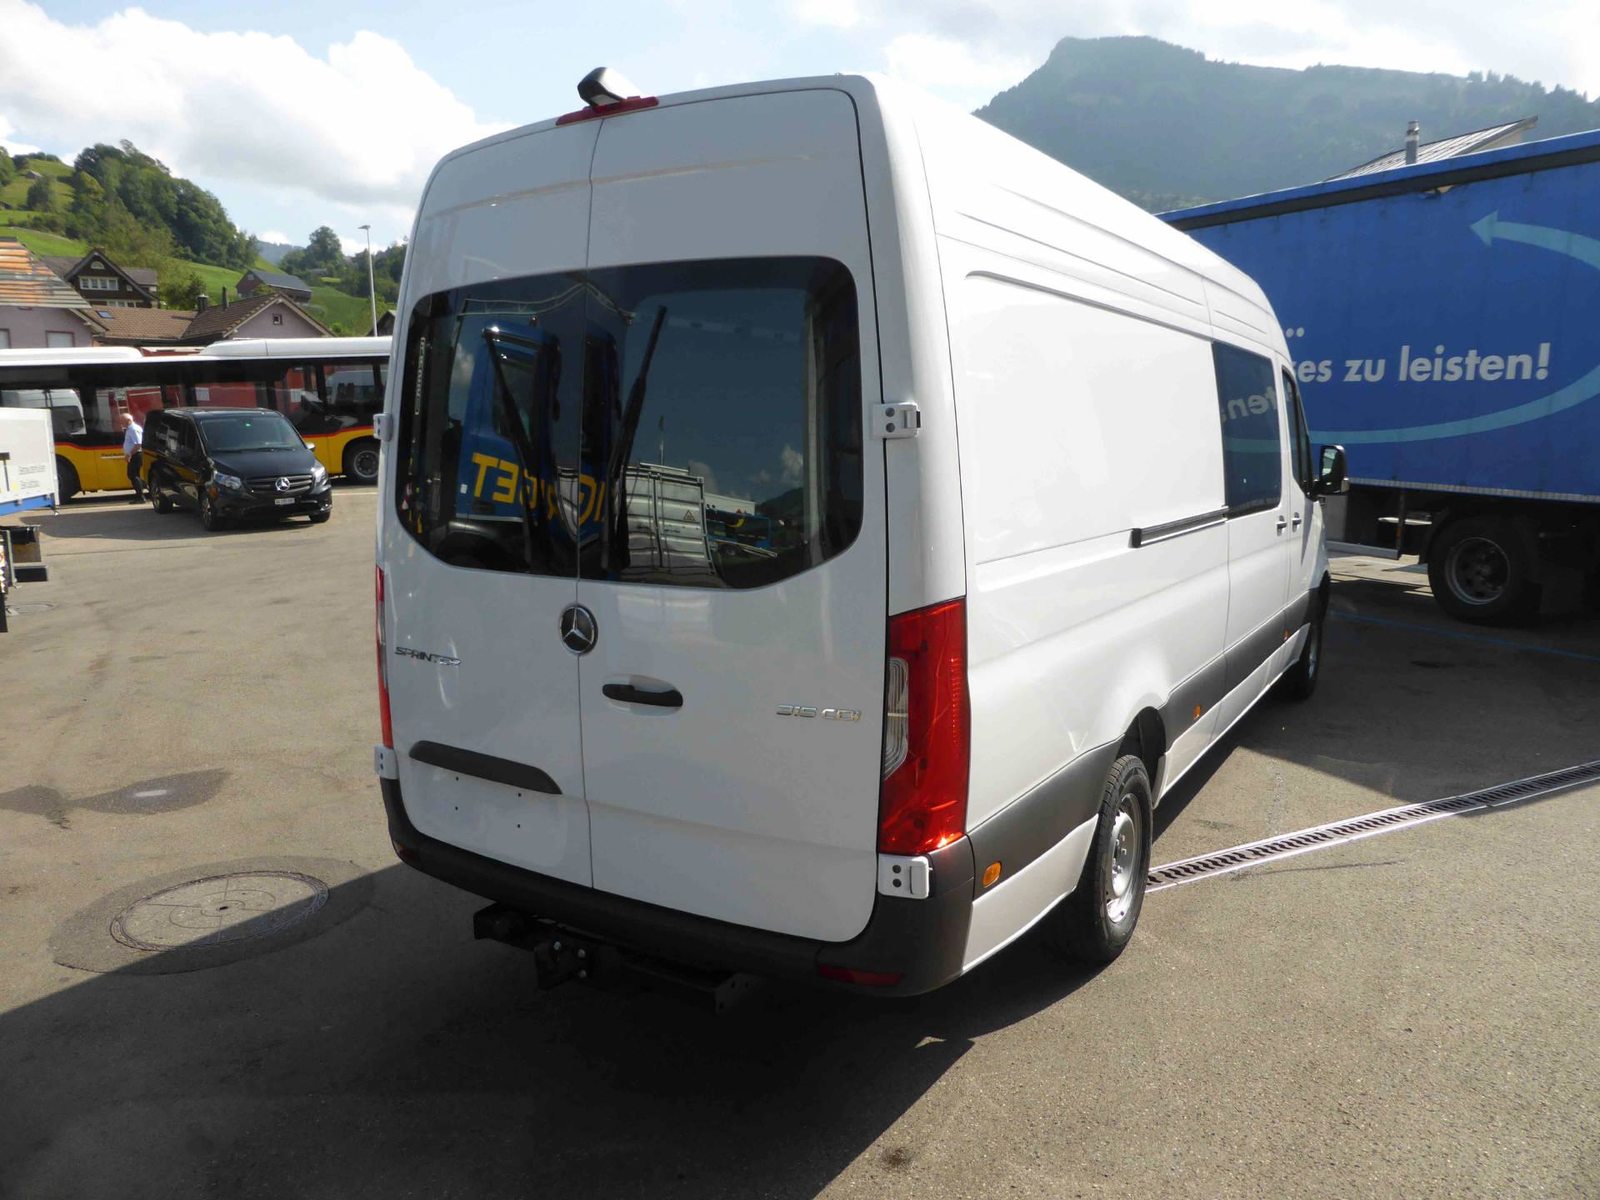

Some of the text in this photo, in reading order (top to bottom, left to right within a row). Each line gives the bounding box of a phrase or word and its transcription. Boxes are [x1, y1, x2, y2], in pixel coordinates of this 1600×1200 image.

[1291, 342, 1551, 383] es zu leisten!
